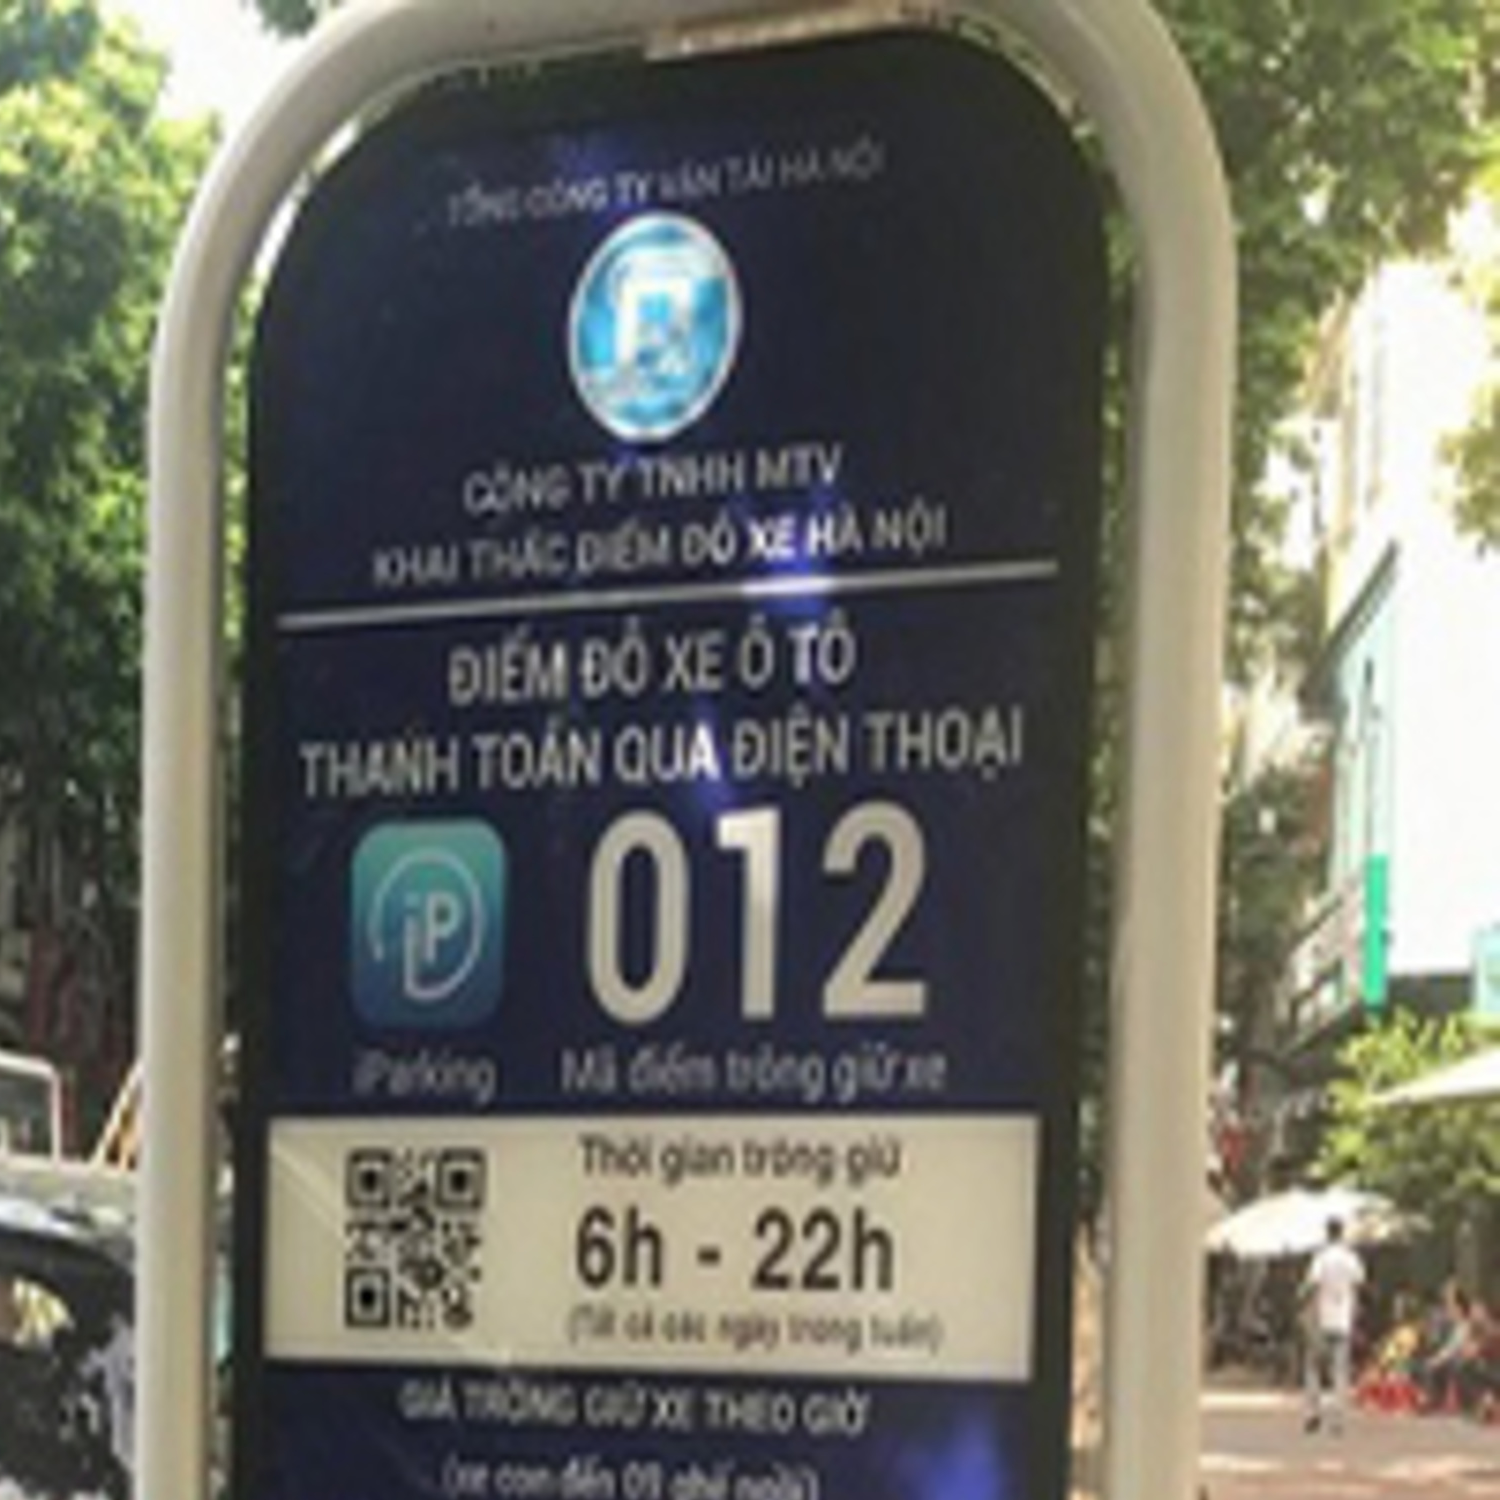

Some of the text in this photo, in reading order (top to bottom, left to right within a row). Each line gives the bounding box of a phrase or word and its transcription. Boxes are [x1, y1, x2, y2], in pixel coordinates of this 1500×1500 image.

[578, 463, 623, 503] TY
[633, 453, 743, 497] TNHH
[756, 444, 843, 490] MTV
[372, 545, 459, 587] KHAI
[747, 516, 797, 559] XE
[807, 505, 862, 557] HÀ
[663, 630, 726, 691] XE
[739, 612, 774, 690] Ô
[787, 606, 857, 685] TÔ
[300, 701, 1023, 798] THANH TOÁN QUA ĐIỆN THOẠI
[585, 801, 930, 1026] 012
[901, 1055, 947, 1091] xe
[660, 1136, 735, 1188] gian
[575, 1204, 895, 1292] 6h - 22h
[651, 1389, 693, 1431] XE
[701, 1392, 795, 1435] THEO
